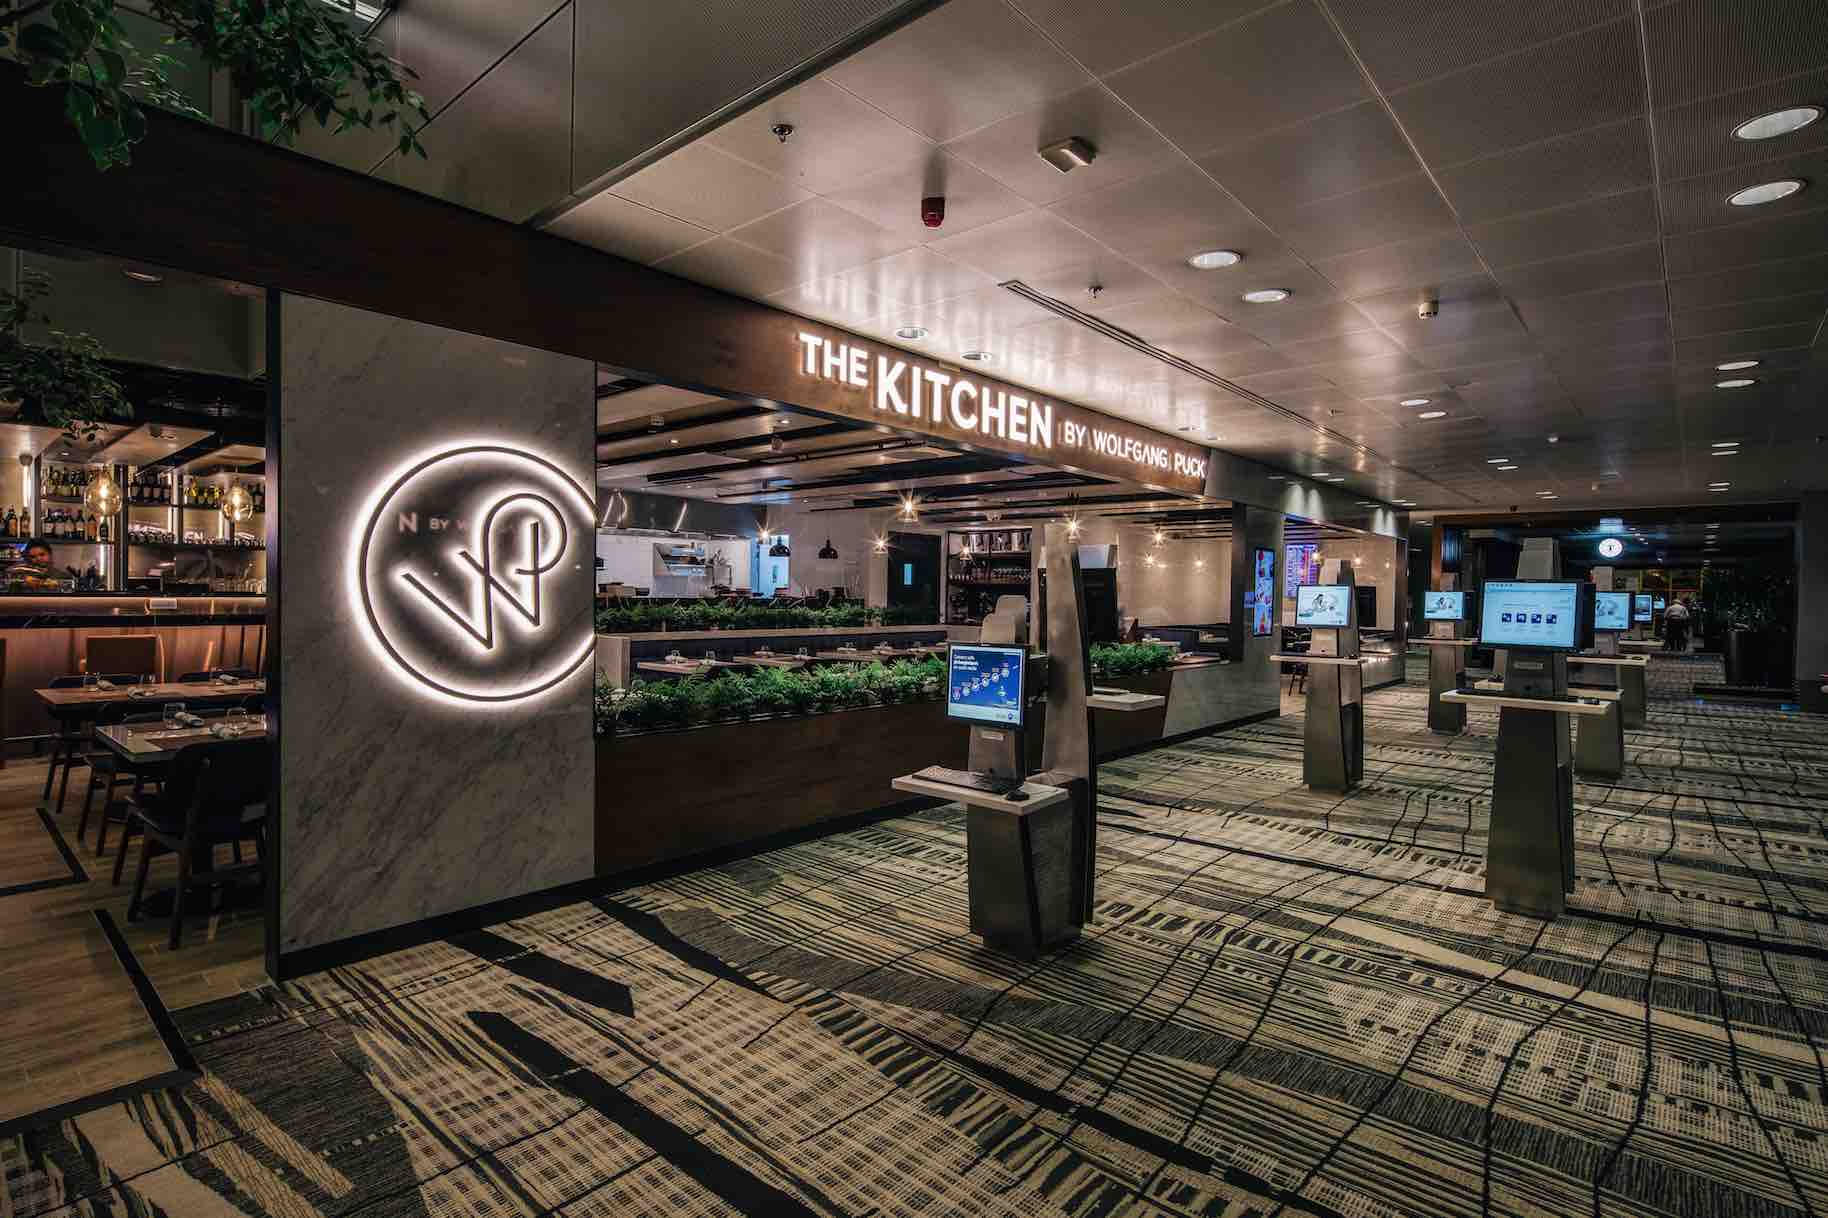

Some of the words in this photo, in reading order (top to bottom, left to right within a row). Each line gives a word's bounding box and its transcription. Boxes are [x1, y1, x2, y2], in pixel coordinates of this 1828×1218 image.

[798, 331, 868, 387] THE
[876, 355, 1052, 449] KITCHEN
[1064, 420, 1087, 448] BY
[1093, 428, 1168, 468] WOLFGANG
[1174, 452, 1206, 478] PUCK
